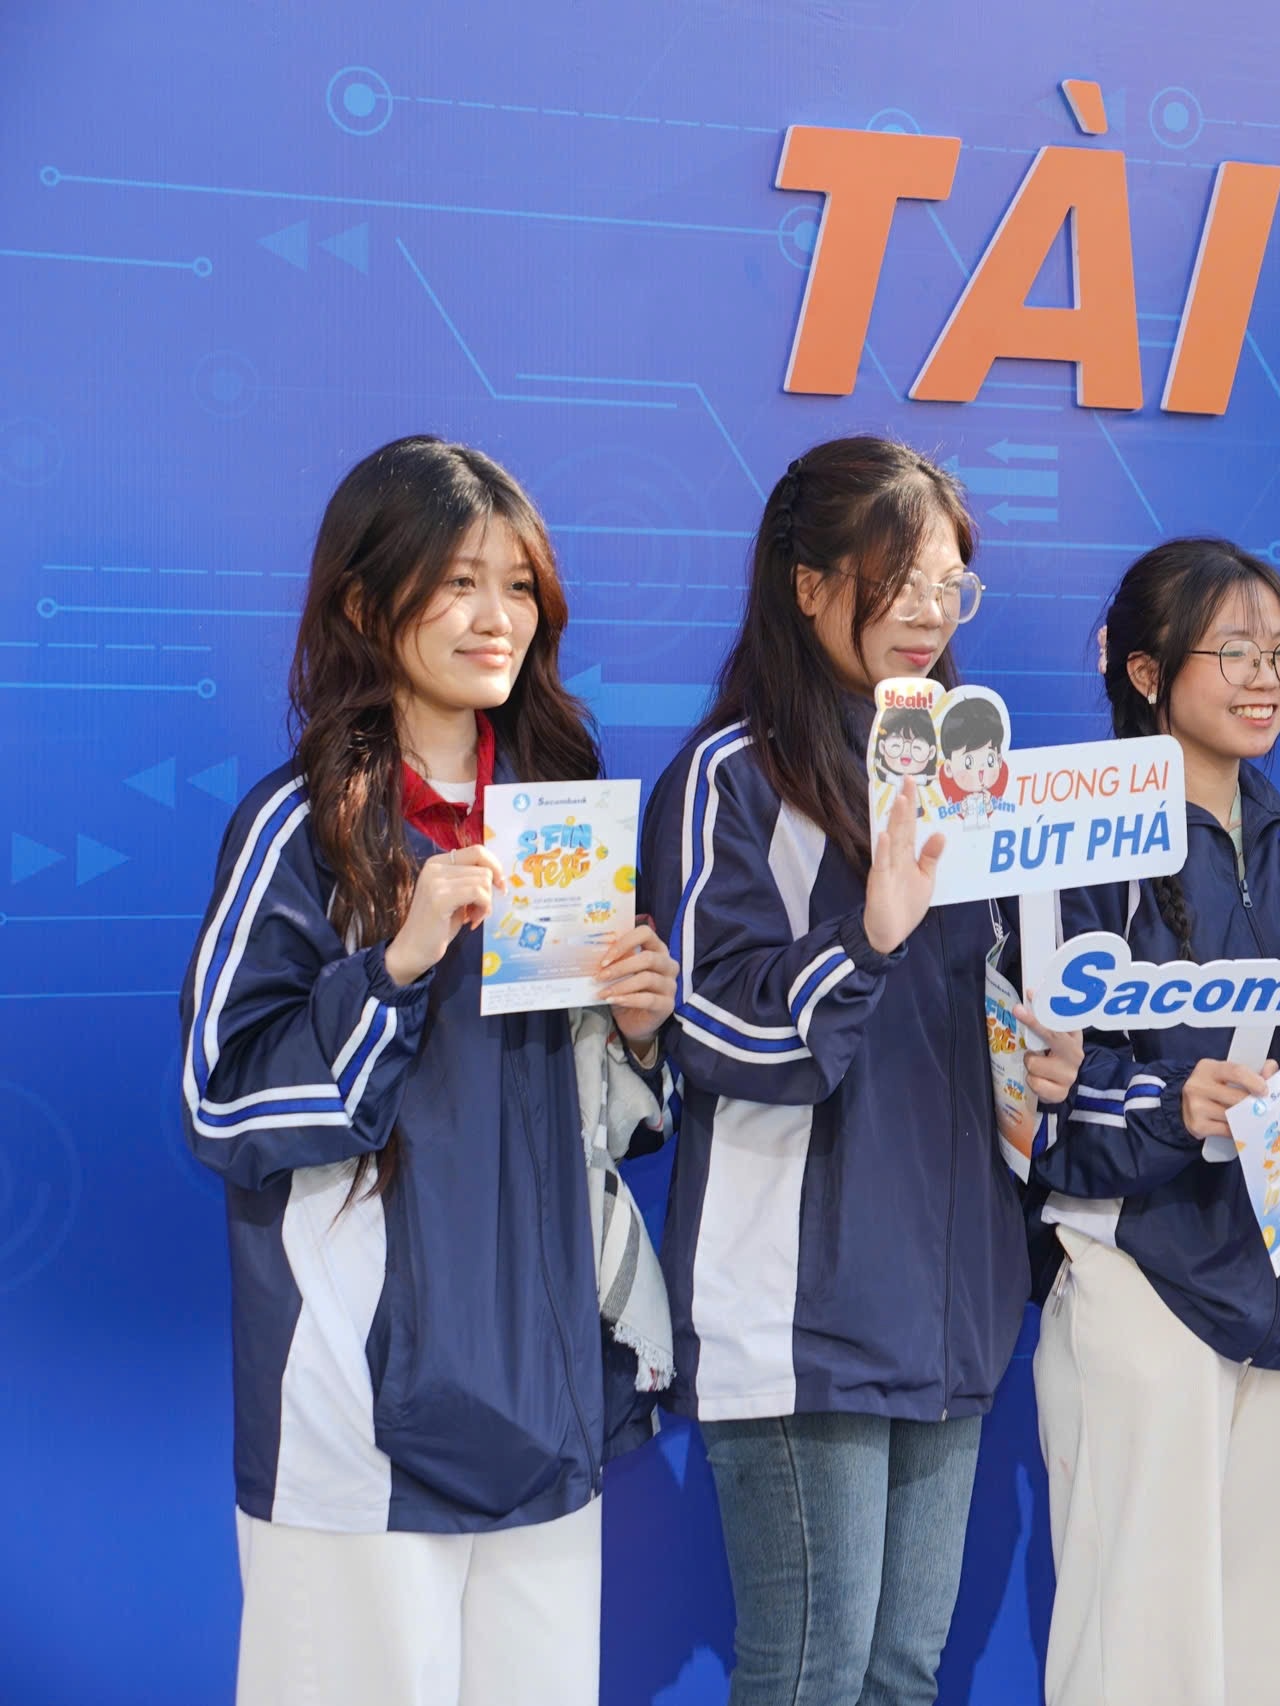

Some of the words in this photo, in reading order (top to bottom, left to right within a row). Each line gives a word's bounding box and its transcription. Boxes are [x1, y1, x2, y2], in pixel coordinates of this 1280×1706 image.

[884, 689, 933, 710] Yeah!
[1016, 767, 1121, 806] TƯƠNG
[1129, 760, 1169, 793] LAI
[540, 824, 593, 851] FIN
[1086, 801, 1171, 861] PHÁ
